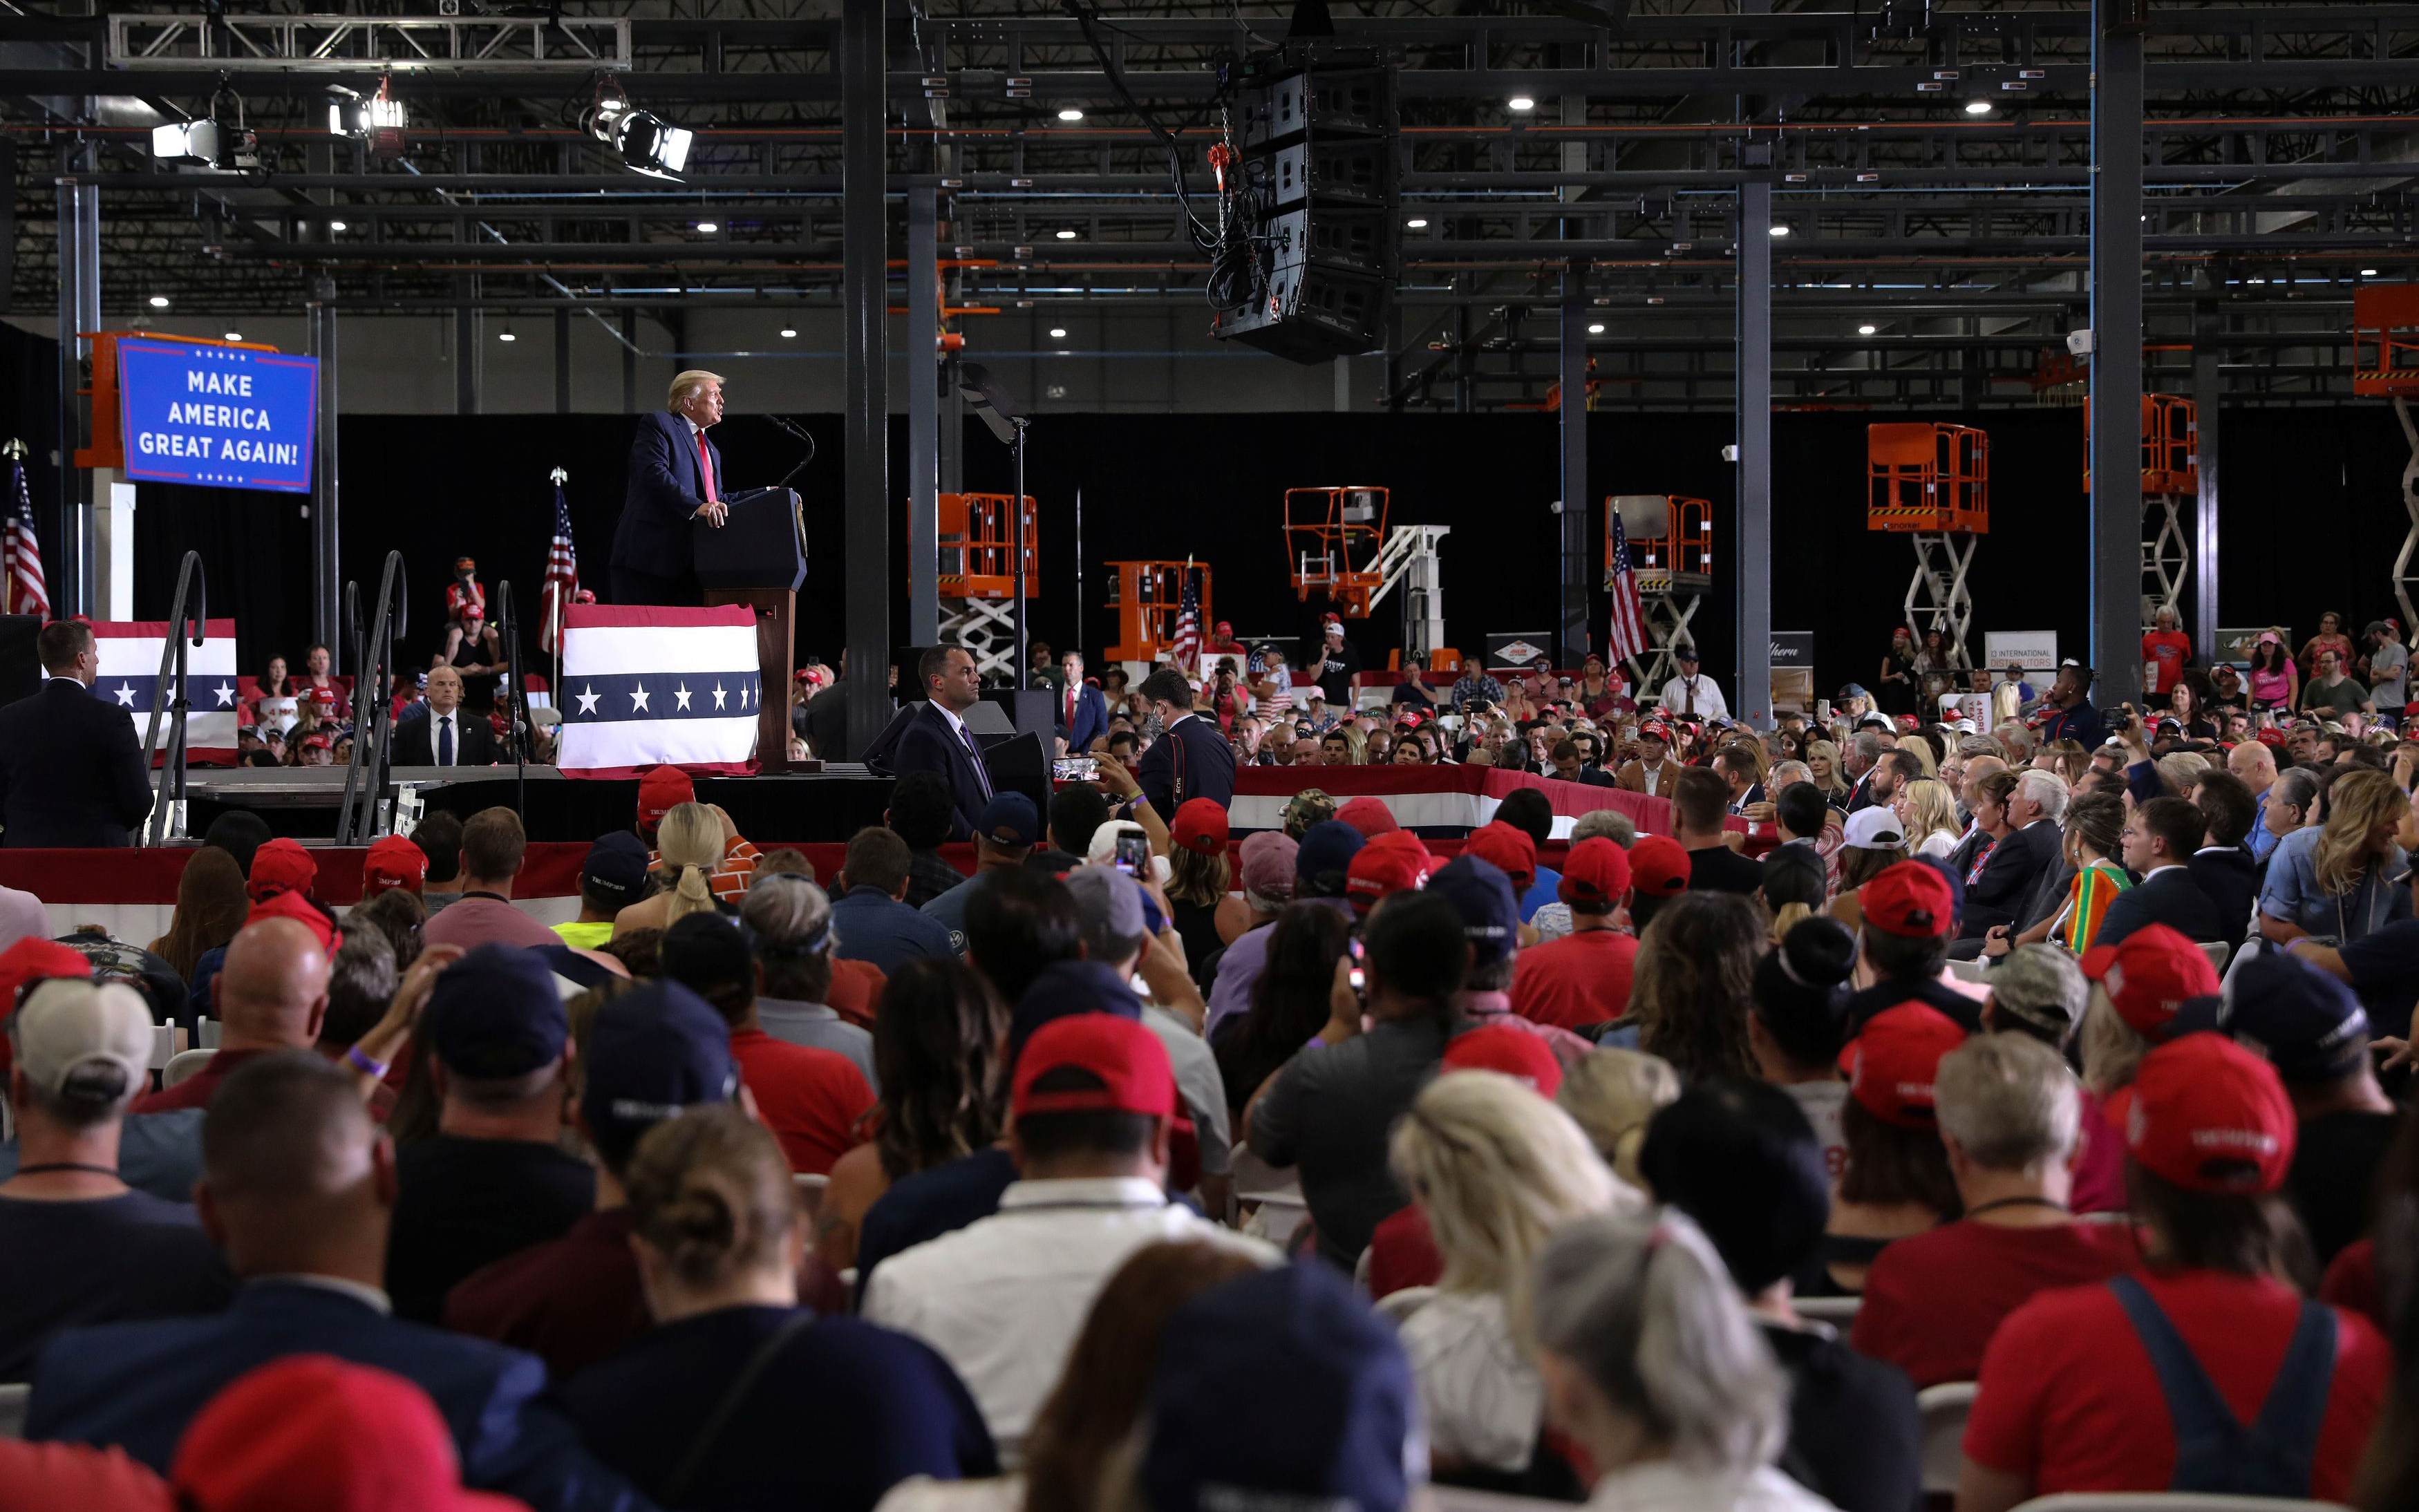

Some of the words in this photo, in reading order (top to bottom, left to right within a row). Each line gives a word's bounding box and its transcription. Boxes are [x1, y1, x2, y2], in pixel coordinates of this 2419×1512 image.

[187, 370, 252, 397] MAKE
[167, 401, 271, 431] AMERICA
[139, 431, 213, 459] GREAT
[220, 438, 297, 465] AGAIN!
[1999, 650, 2051, 658] INTERNATIONAL
